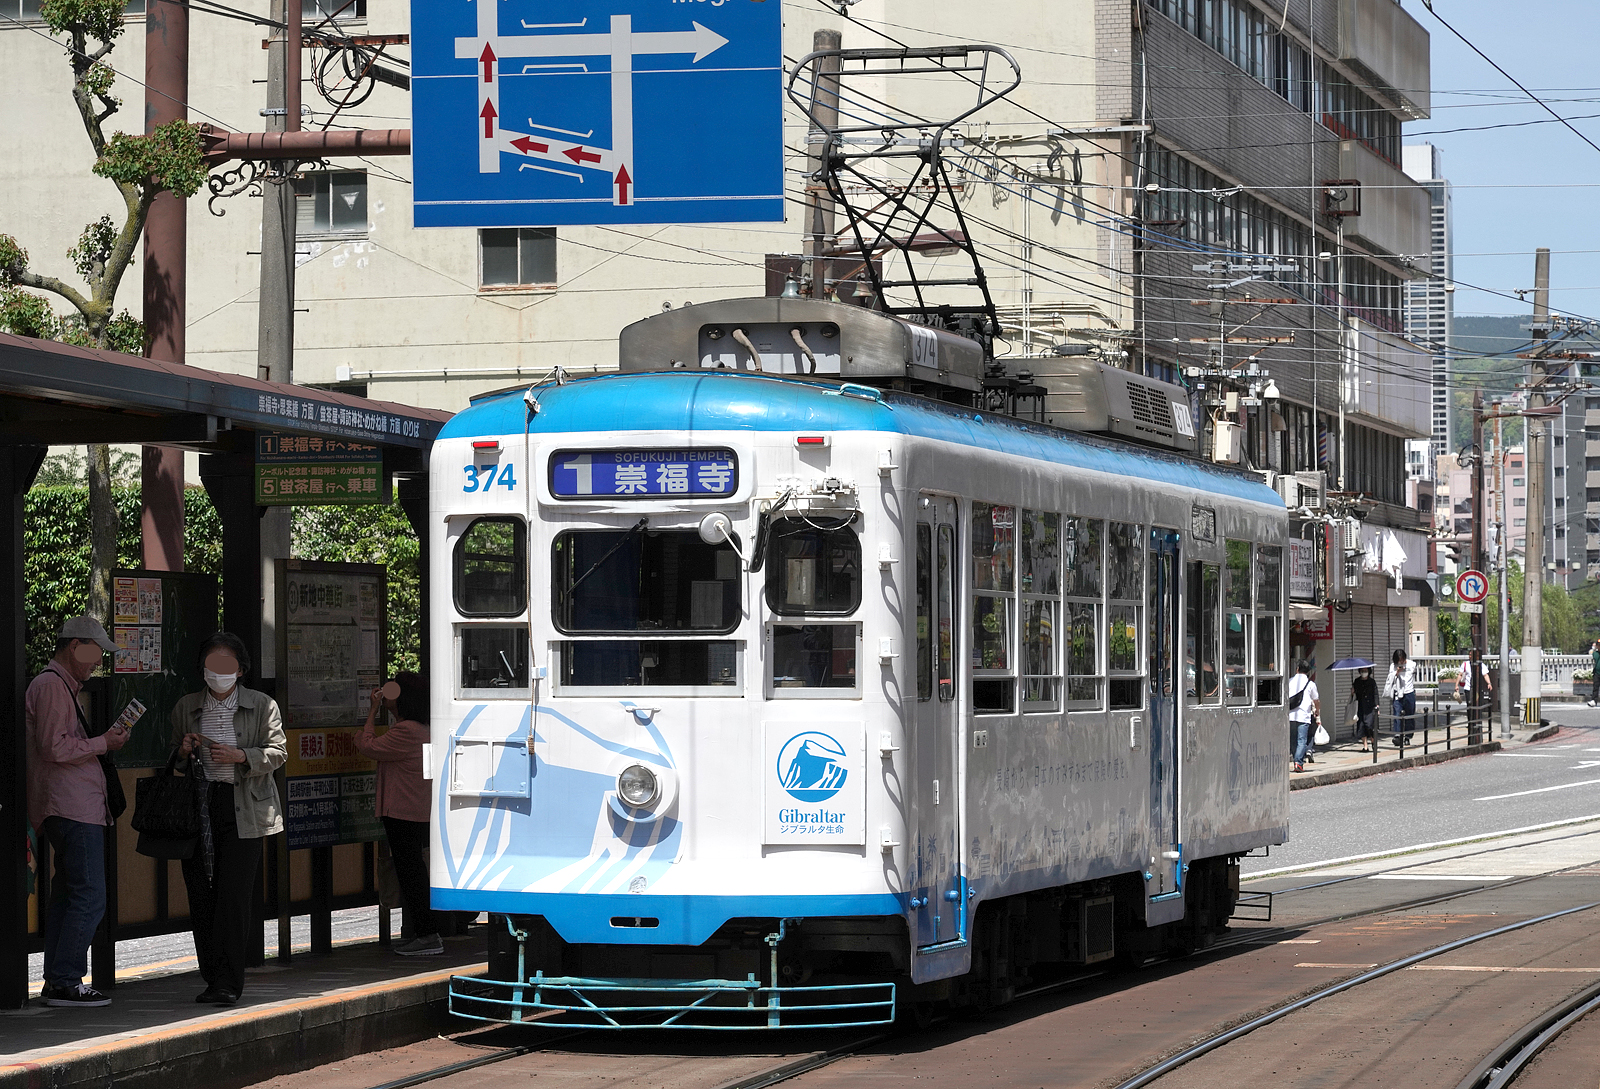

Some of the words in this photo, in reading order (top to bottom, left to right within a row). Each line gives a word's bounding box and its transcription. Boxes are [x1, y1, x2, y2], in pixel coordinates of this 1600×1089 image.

[915, 328, 935, 366] 374
[402, 420, 420, 438] のりば
[264, 438, 271, 452] 1
[279, 437, 323, 452] 崇福寺
[325, 440, 345, 451] 行へ
[615, 452, 676, 462] SOFUKUJI
[681, 451, 731, 462] TEMPLE
[263, 479, 274, 494] 5
[279, 478, 324, 494] 蛍茶屋
[325, 482, 345, 493] 行へ
[347, 478, 377, 493] 乗車
[463, 463, 517, 493] 374
[563, 454, 593, 495] 1
[615, 462, 732, 494] 崇福寺
[299, 583, 343, 608] 新地中華街
[301, 735, 324, 758] 乗換え
[1246, 741, 1283, 788] Gibraltar
[779, 808, 846, 829] Gibraltar
[780, 824, 845, 835] ジブラルタ生命
